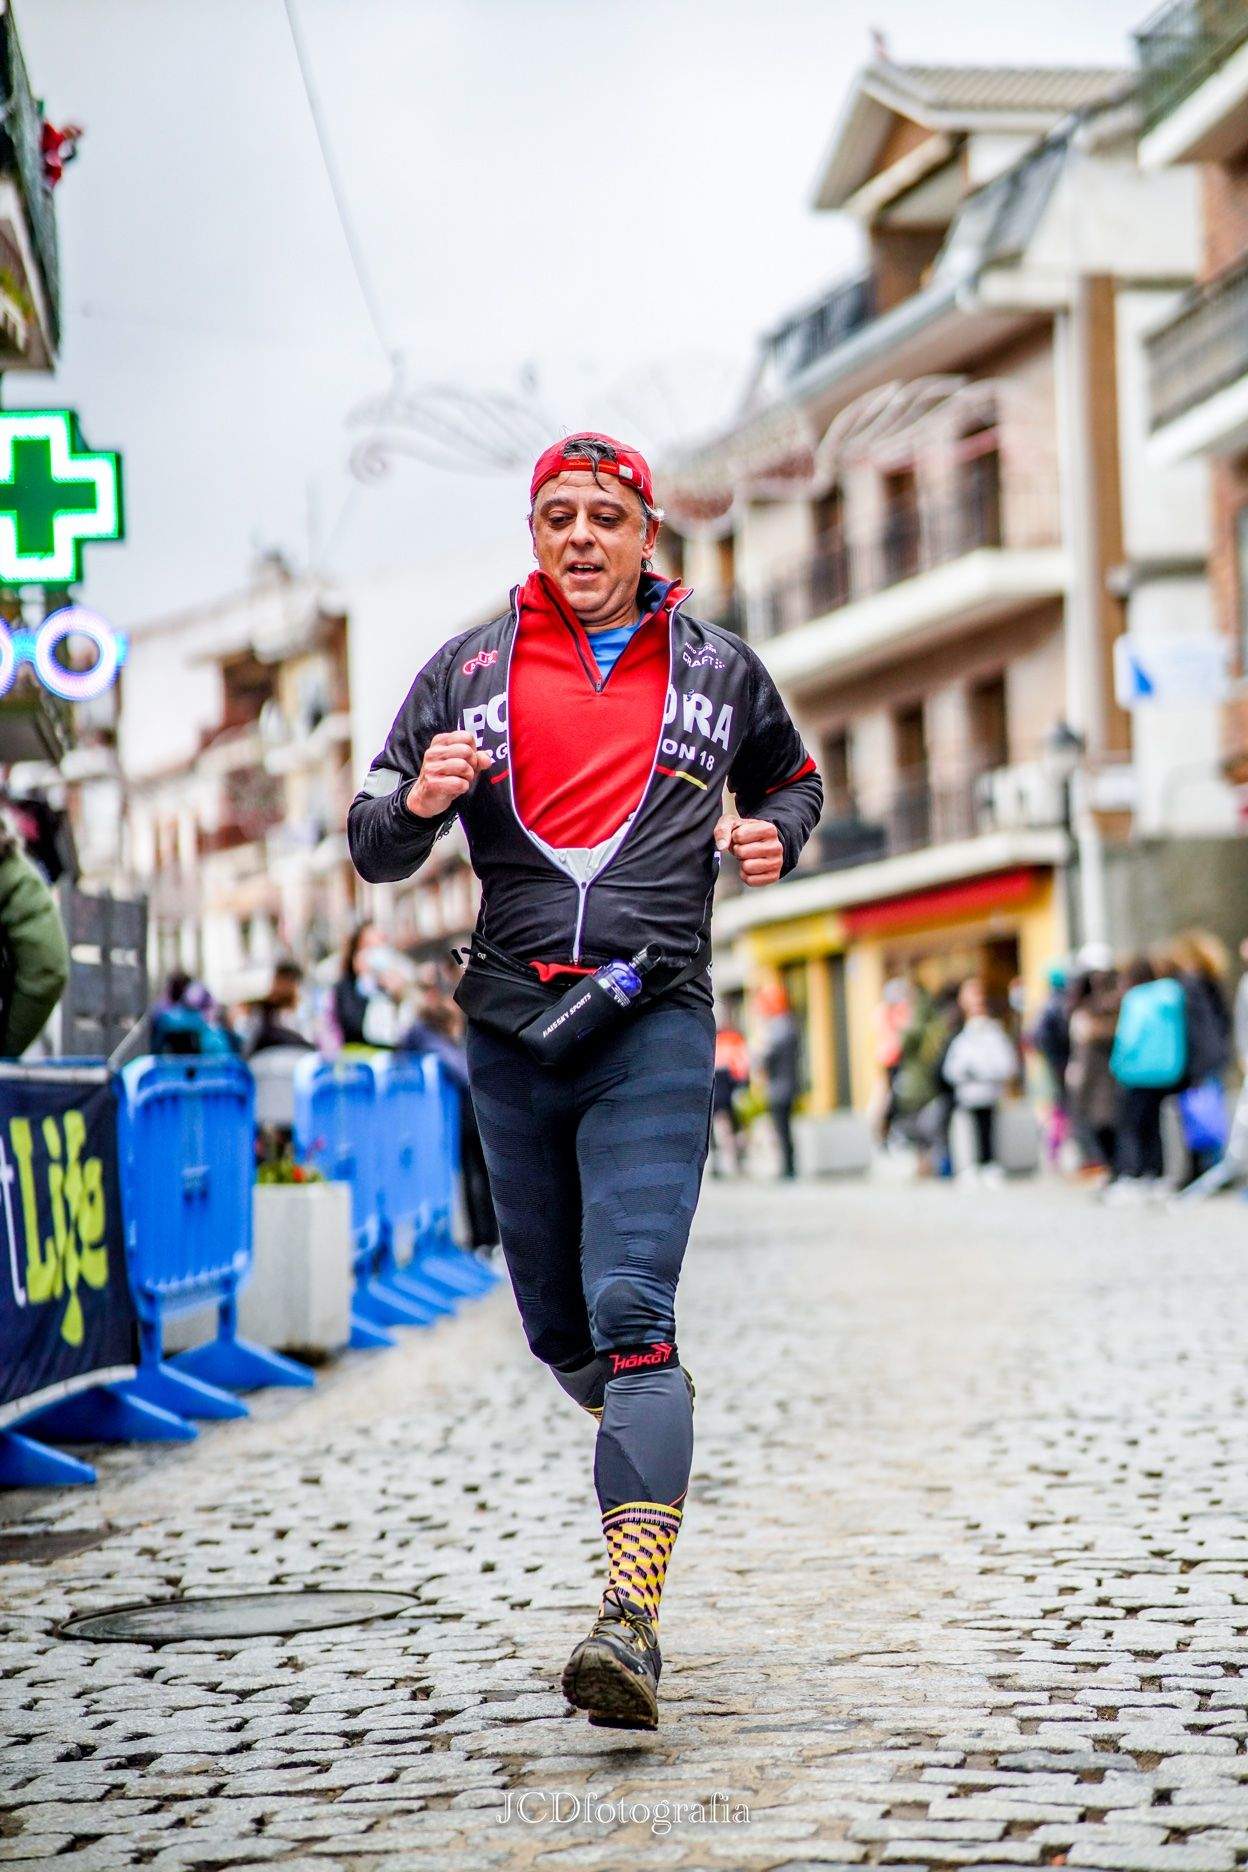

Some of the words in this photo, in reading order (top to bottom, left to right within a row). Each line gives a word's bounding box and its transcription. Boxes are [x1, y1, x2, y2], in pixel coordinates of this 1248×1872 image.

[683, 651, 714, 668] CRAFT
[699, 750, 715, 771] 18
[569, 992, 592, 1015] SPORTS
[9, 1109, 108, 1346] Life
